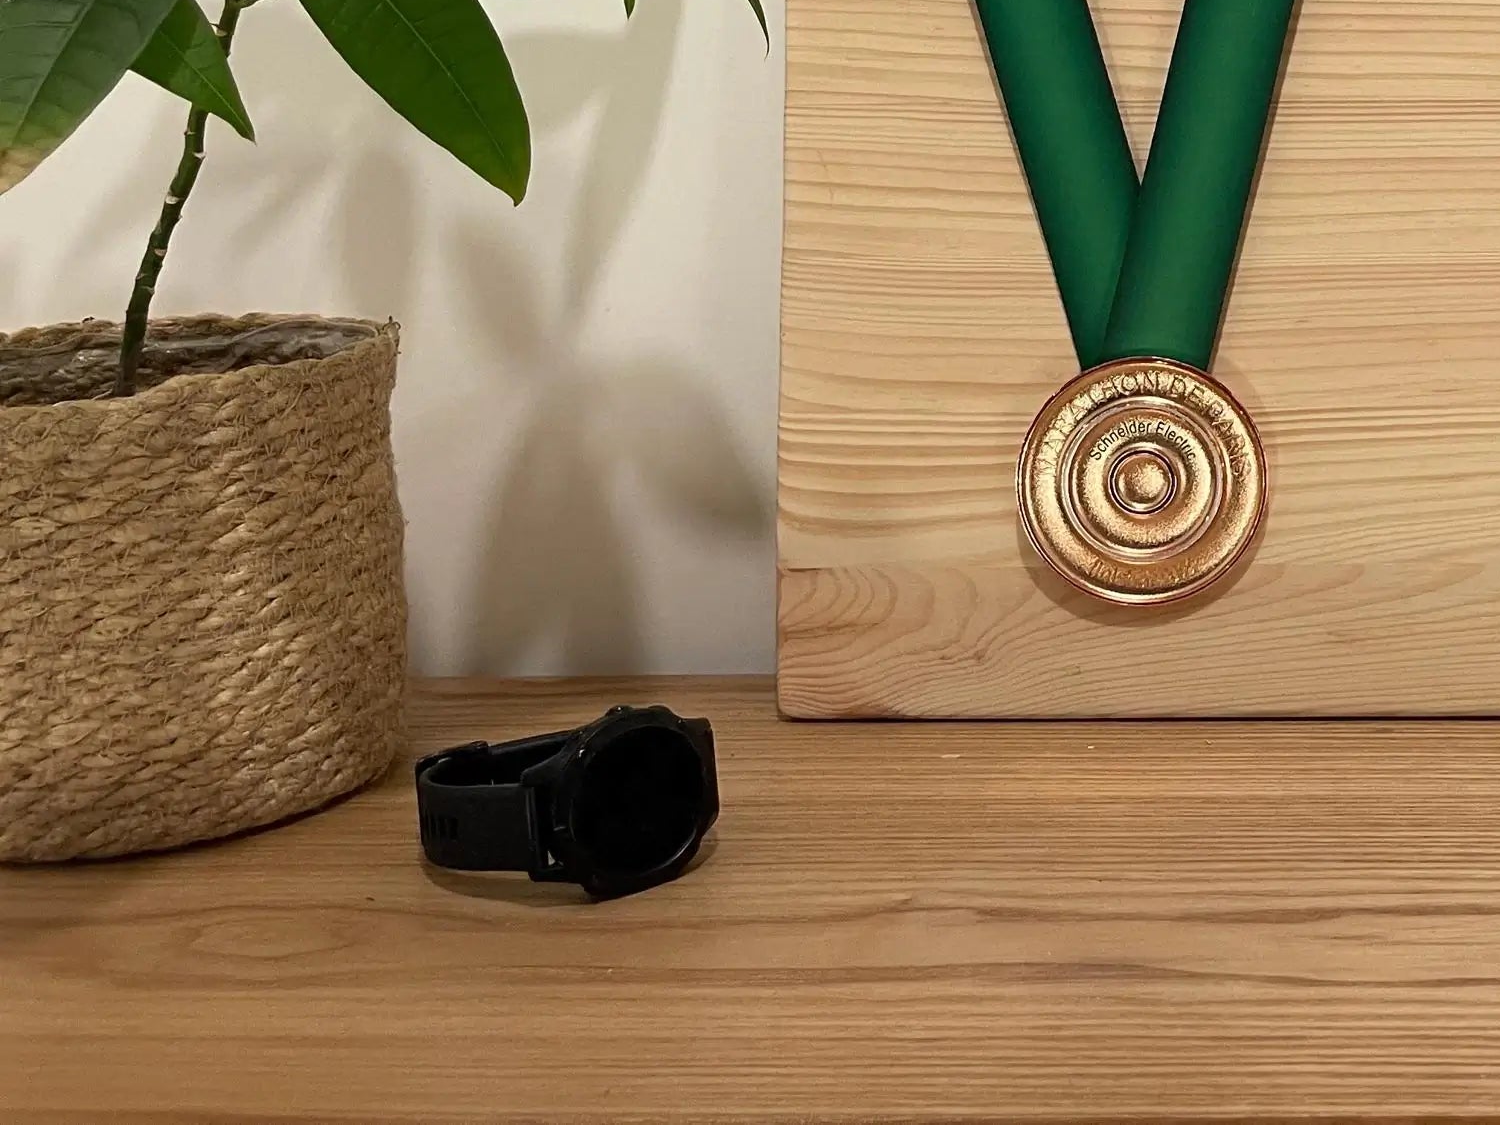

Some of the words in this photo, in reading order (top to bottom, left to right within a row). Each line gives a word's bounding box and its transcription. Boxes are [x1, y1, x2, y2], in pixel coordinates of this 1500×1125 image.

[1169, 374, 1206, 405] DE
[1090, 421, 1153, 461] Schneider
[1156, 422, 1196, 461] Electric
